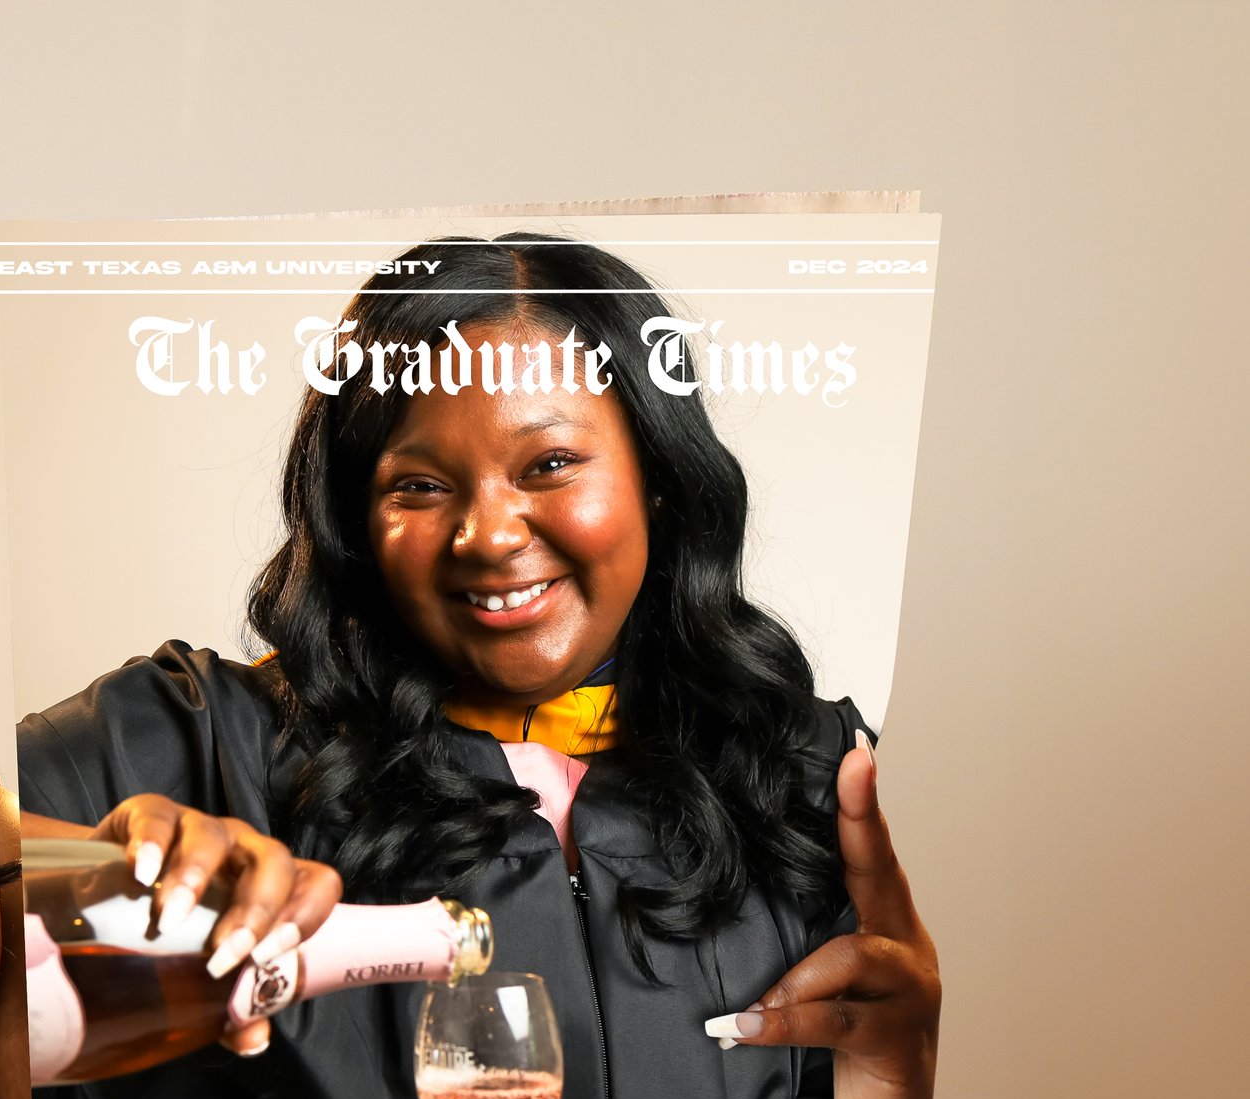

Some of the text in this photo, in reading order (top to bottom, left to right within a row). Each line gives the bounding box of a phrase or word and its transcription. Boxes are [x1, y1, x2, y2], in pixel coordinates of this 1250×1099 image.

[83, 261, 182, 275] TEXAS
[192, 261, 258, 275] A&M
[266, 260, 442, 275] UNIVERSITY
[788, 260, 930, 275] DEC 2024
[128, 316, 859, 410] The Graduate Times
